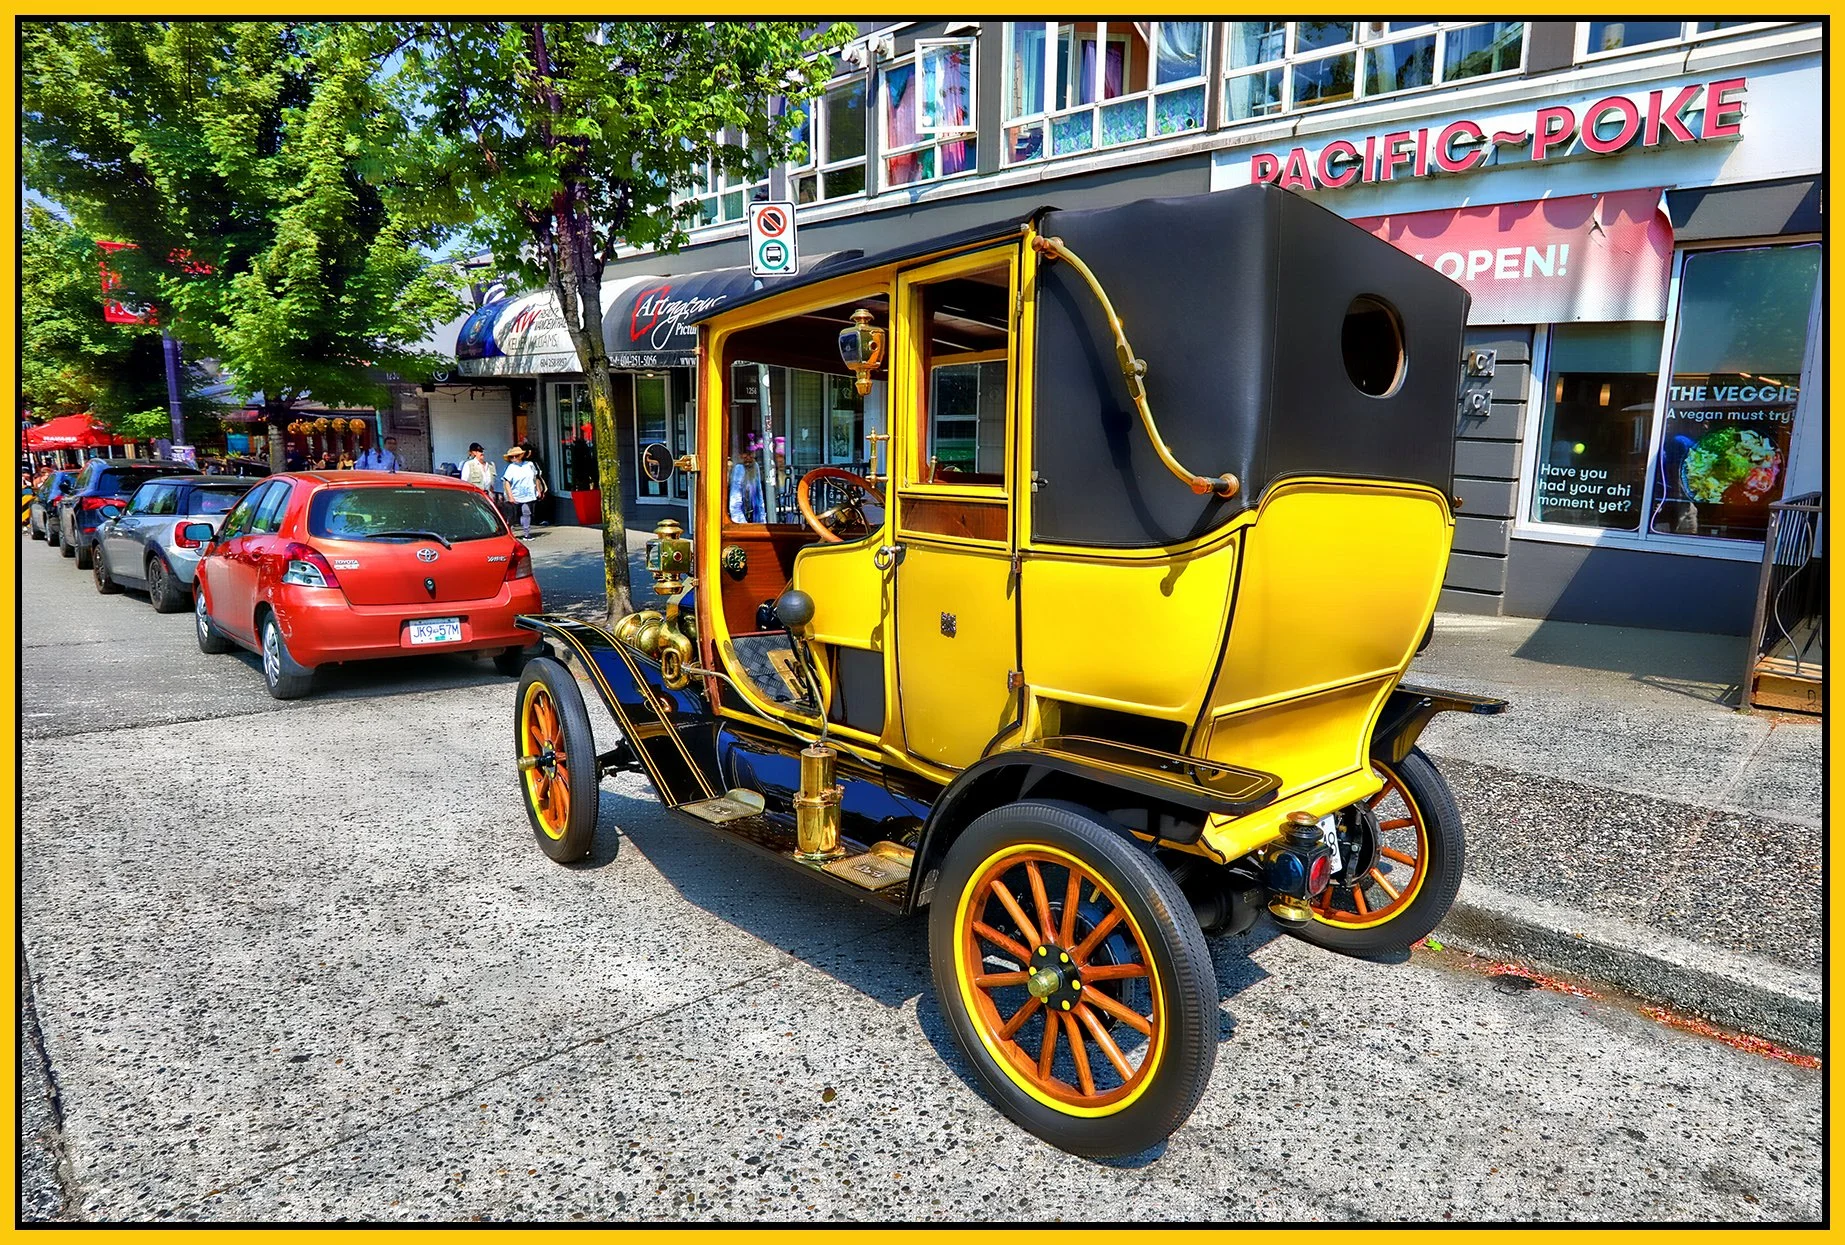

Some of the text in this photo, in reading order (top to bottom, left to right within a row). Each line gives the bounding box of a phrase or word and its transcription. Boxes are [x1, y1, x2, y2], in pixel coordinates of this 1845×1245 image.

[1434, 244, 1569, 281] OPEN!
[1670, 386, 1798, 402] THE VEGGIE
[1666, 408, 1676, 419] A
[1680, 411, 1723, 422] vegan
[1728, 410, 1766, 420] must
[1541, 463, 1607, 481] Have you
[1539, 479, 1631, 497] had your ahi
[1538, 496, 1632, 514] moment yet?
